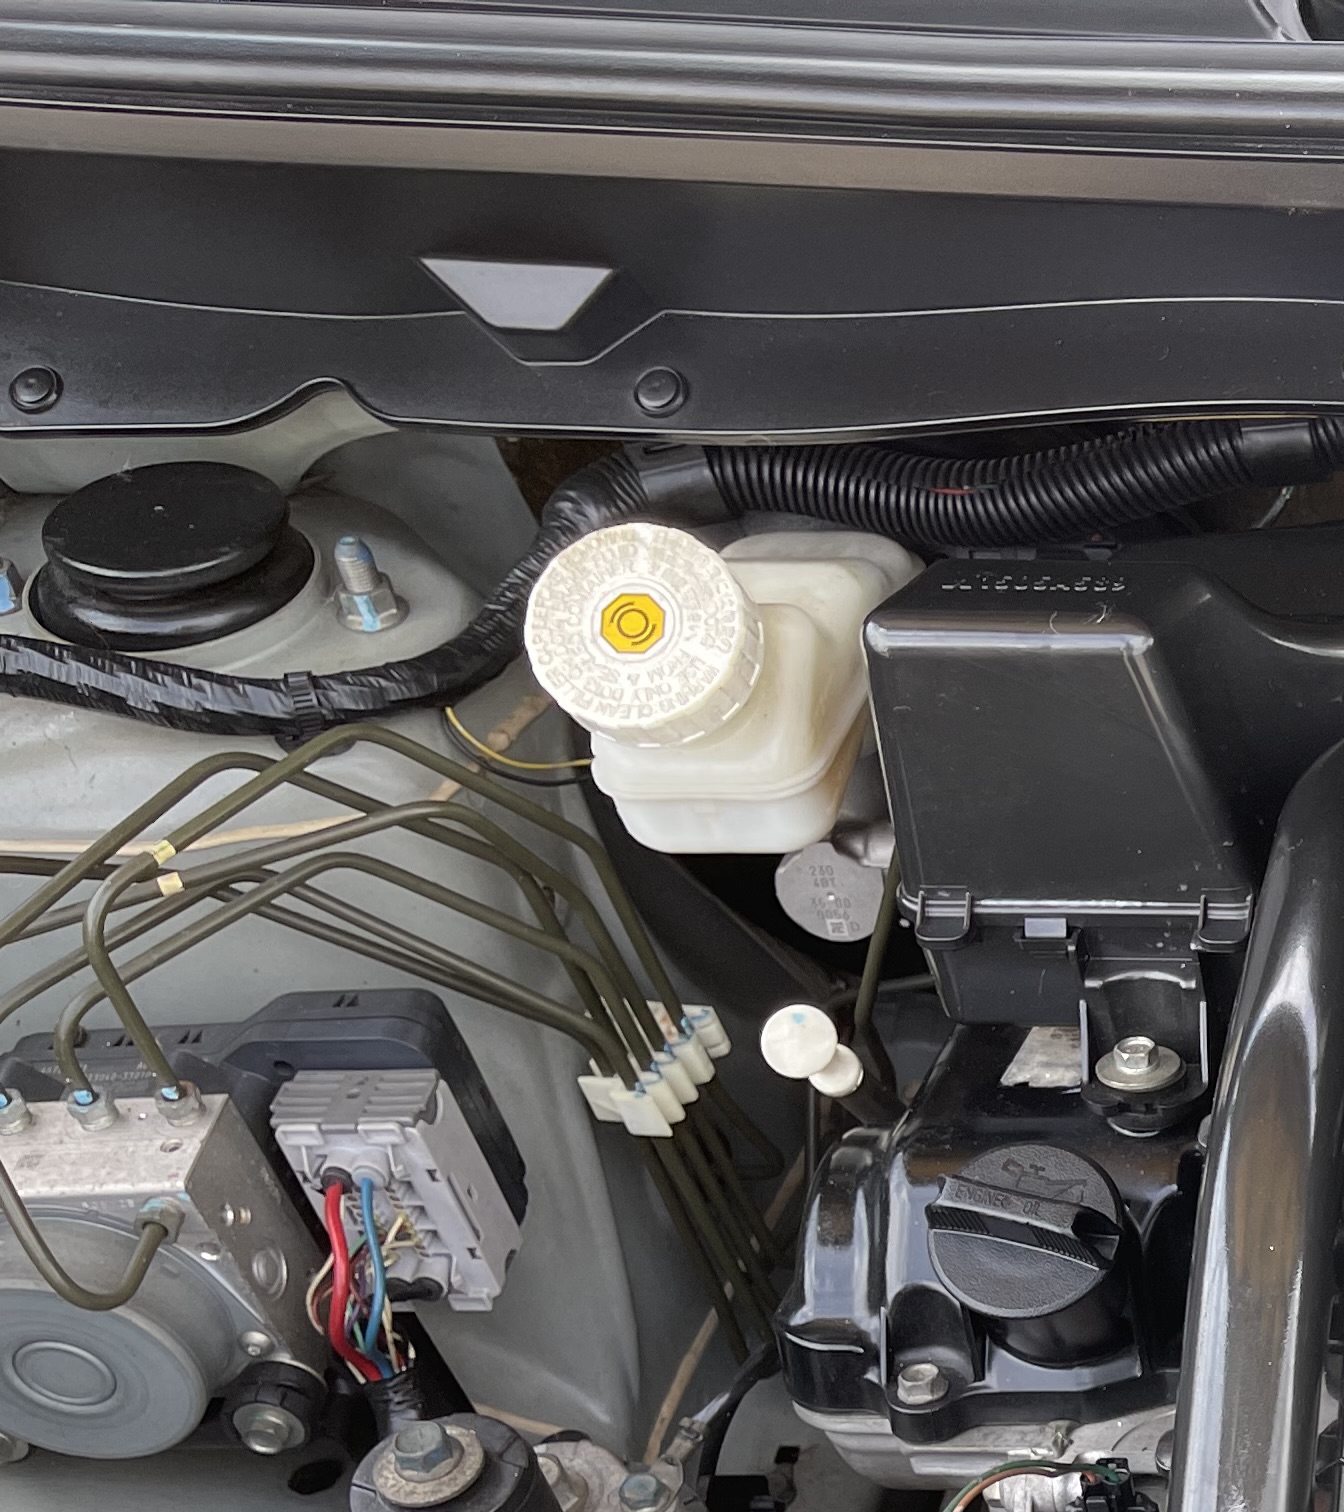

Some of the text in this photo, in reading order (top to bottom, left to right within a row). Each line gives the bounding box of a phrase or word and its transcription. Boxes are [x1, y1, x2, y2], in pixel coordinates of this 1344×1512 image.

[546, 666, 595, 714] FILLER
[632, 678, 675, 703] ONLY
[595, 698, 655, 720] CLEAN
